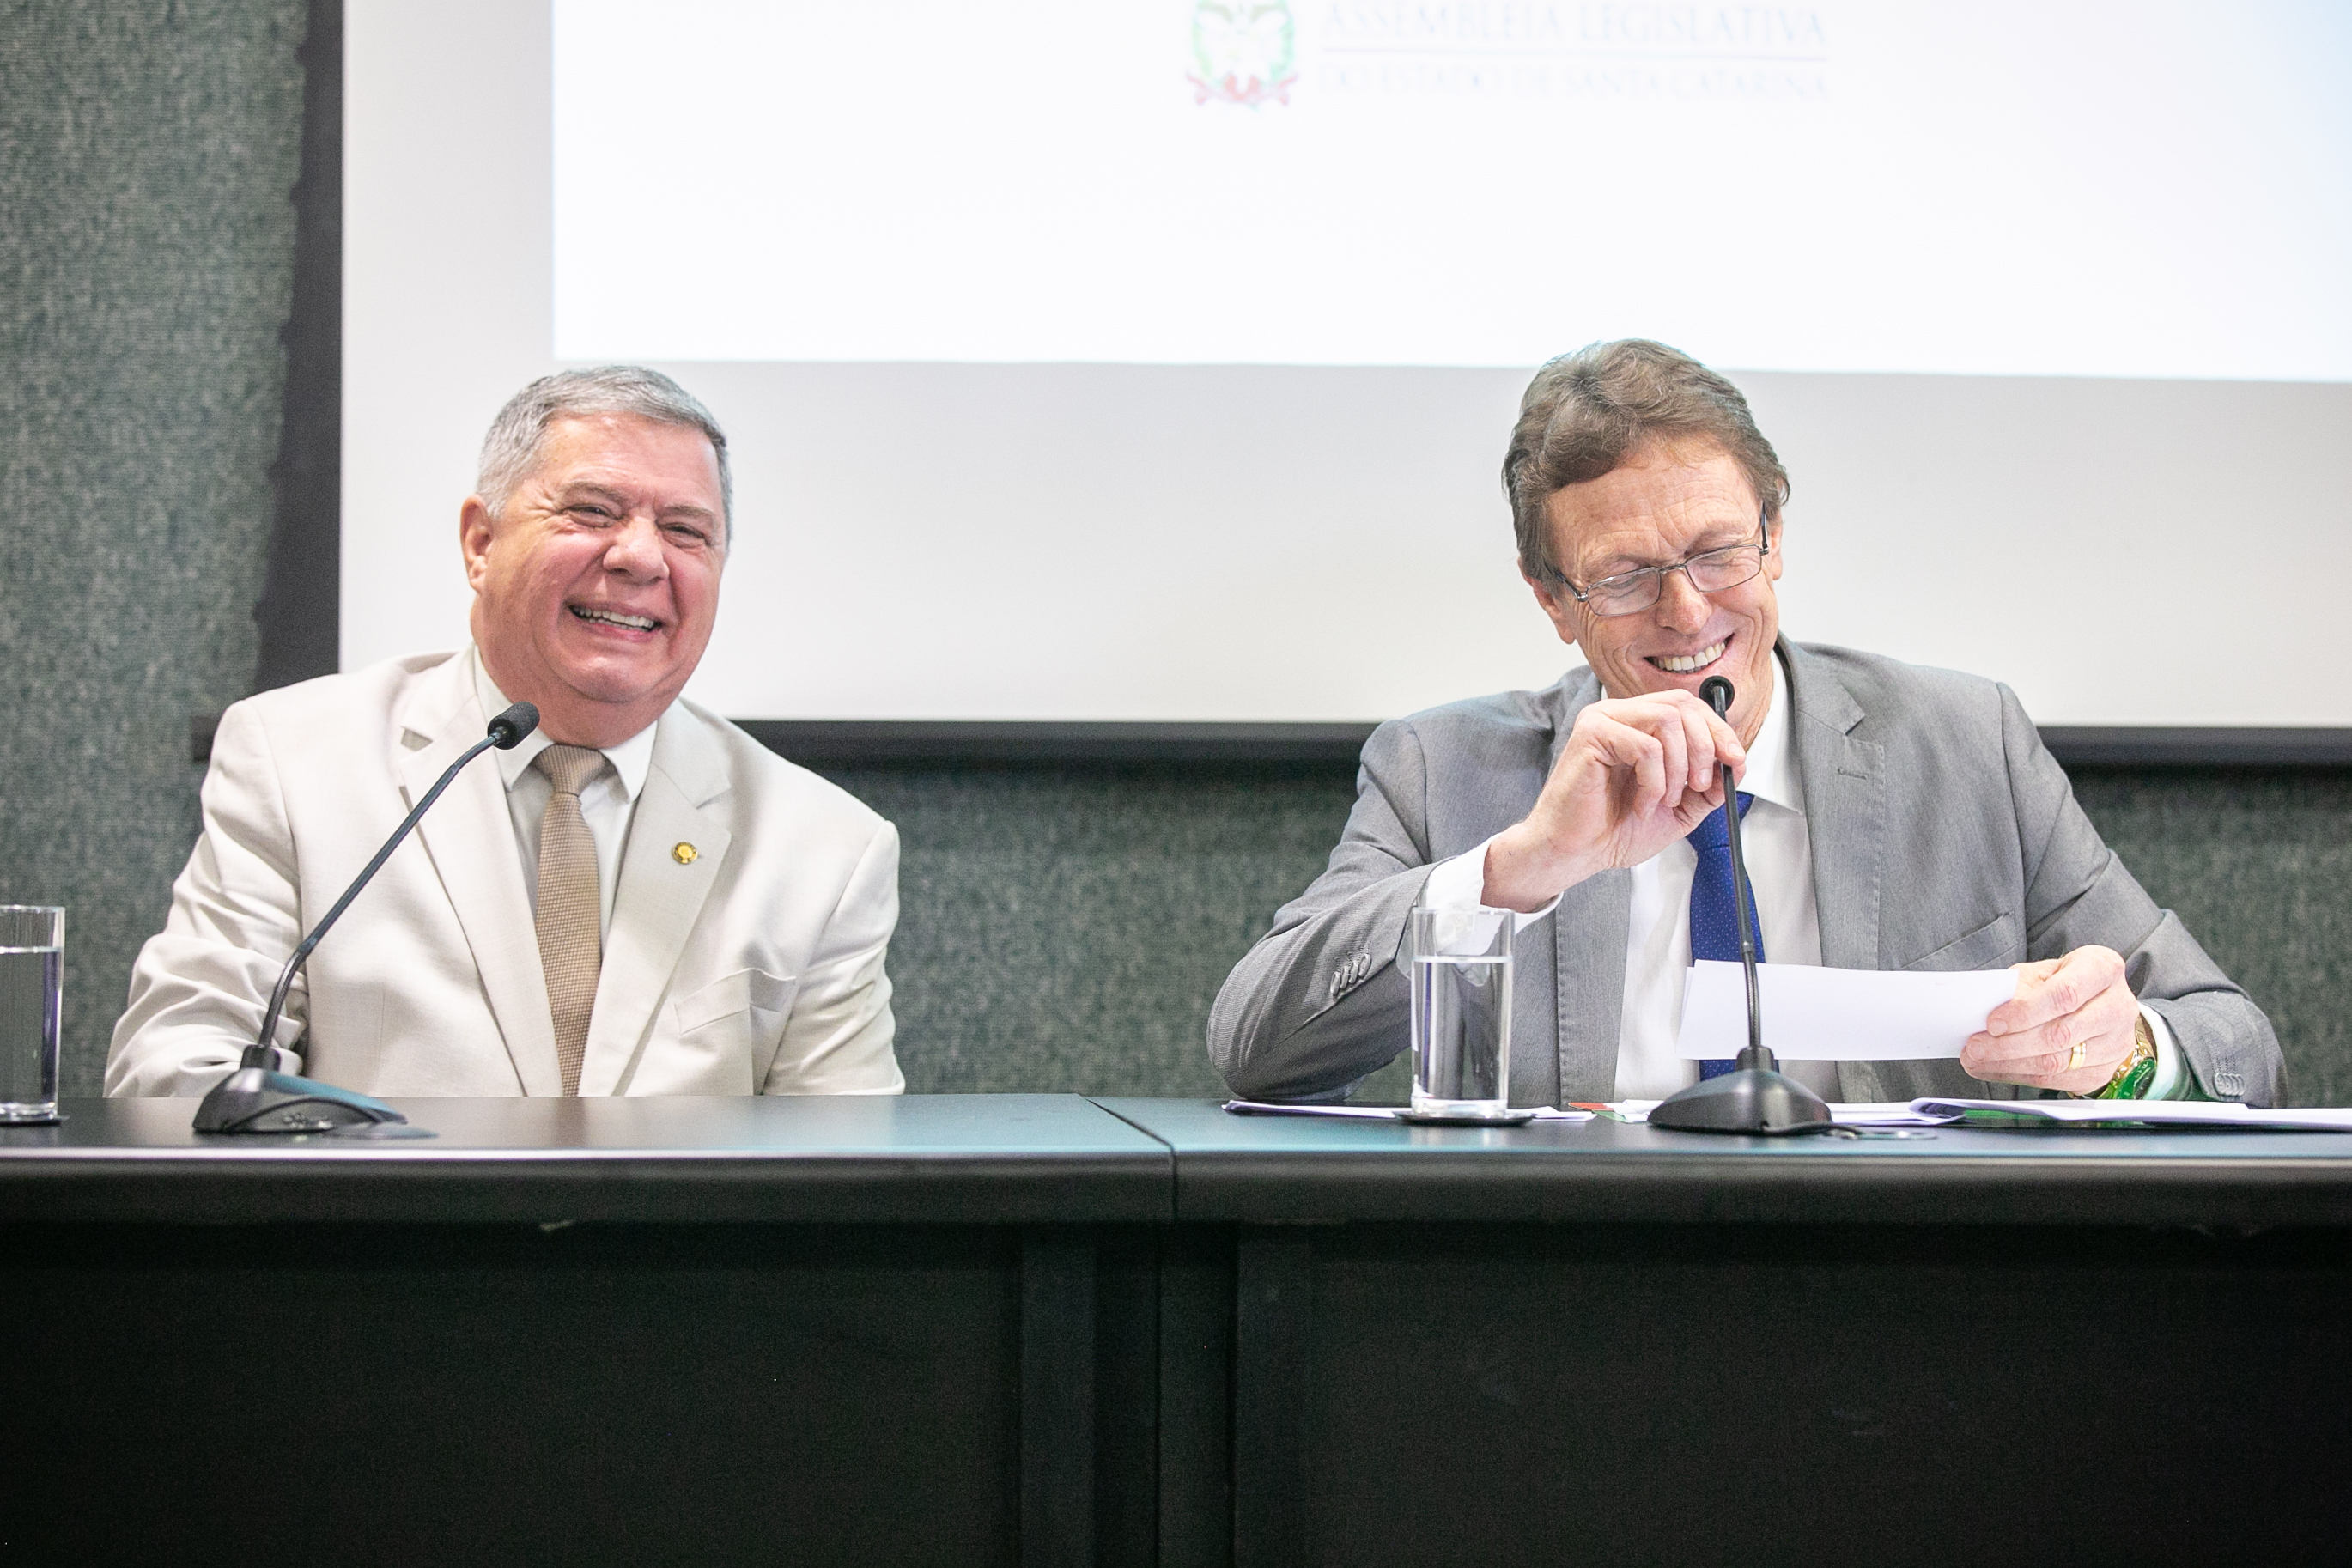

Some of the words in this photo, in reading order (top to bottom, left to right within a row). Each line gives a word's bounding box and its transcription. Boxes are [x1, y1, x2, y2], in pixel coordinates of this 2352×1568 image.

[1322, 2, 1564, 40] ASSEMBLEIA
[1579, 3, 1827, 44] LEGISLATIVA
[1382, 64, 1503, 93] ESTADO
[1566, 67, 1662, 98] SANTA
[1669, 69, 1829, 102] CATARINA
